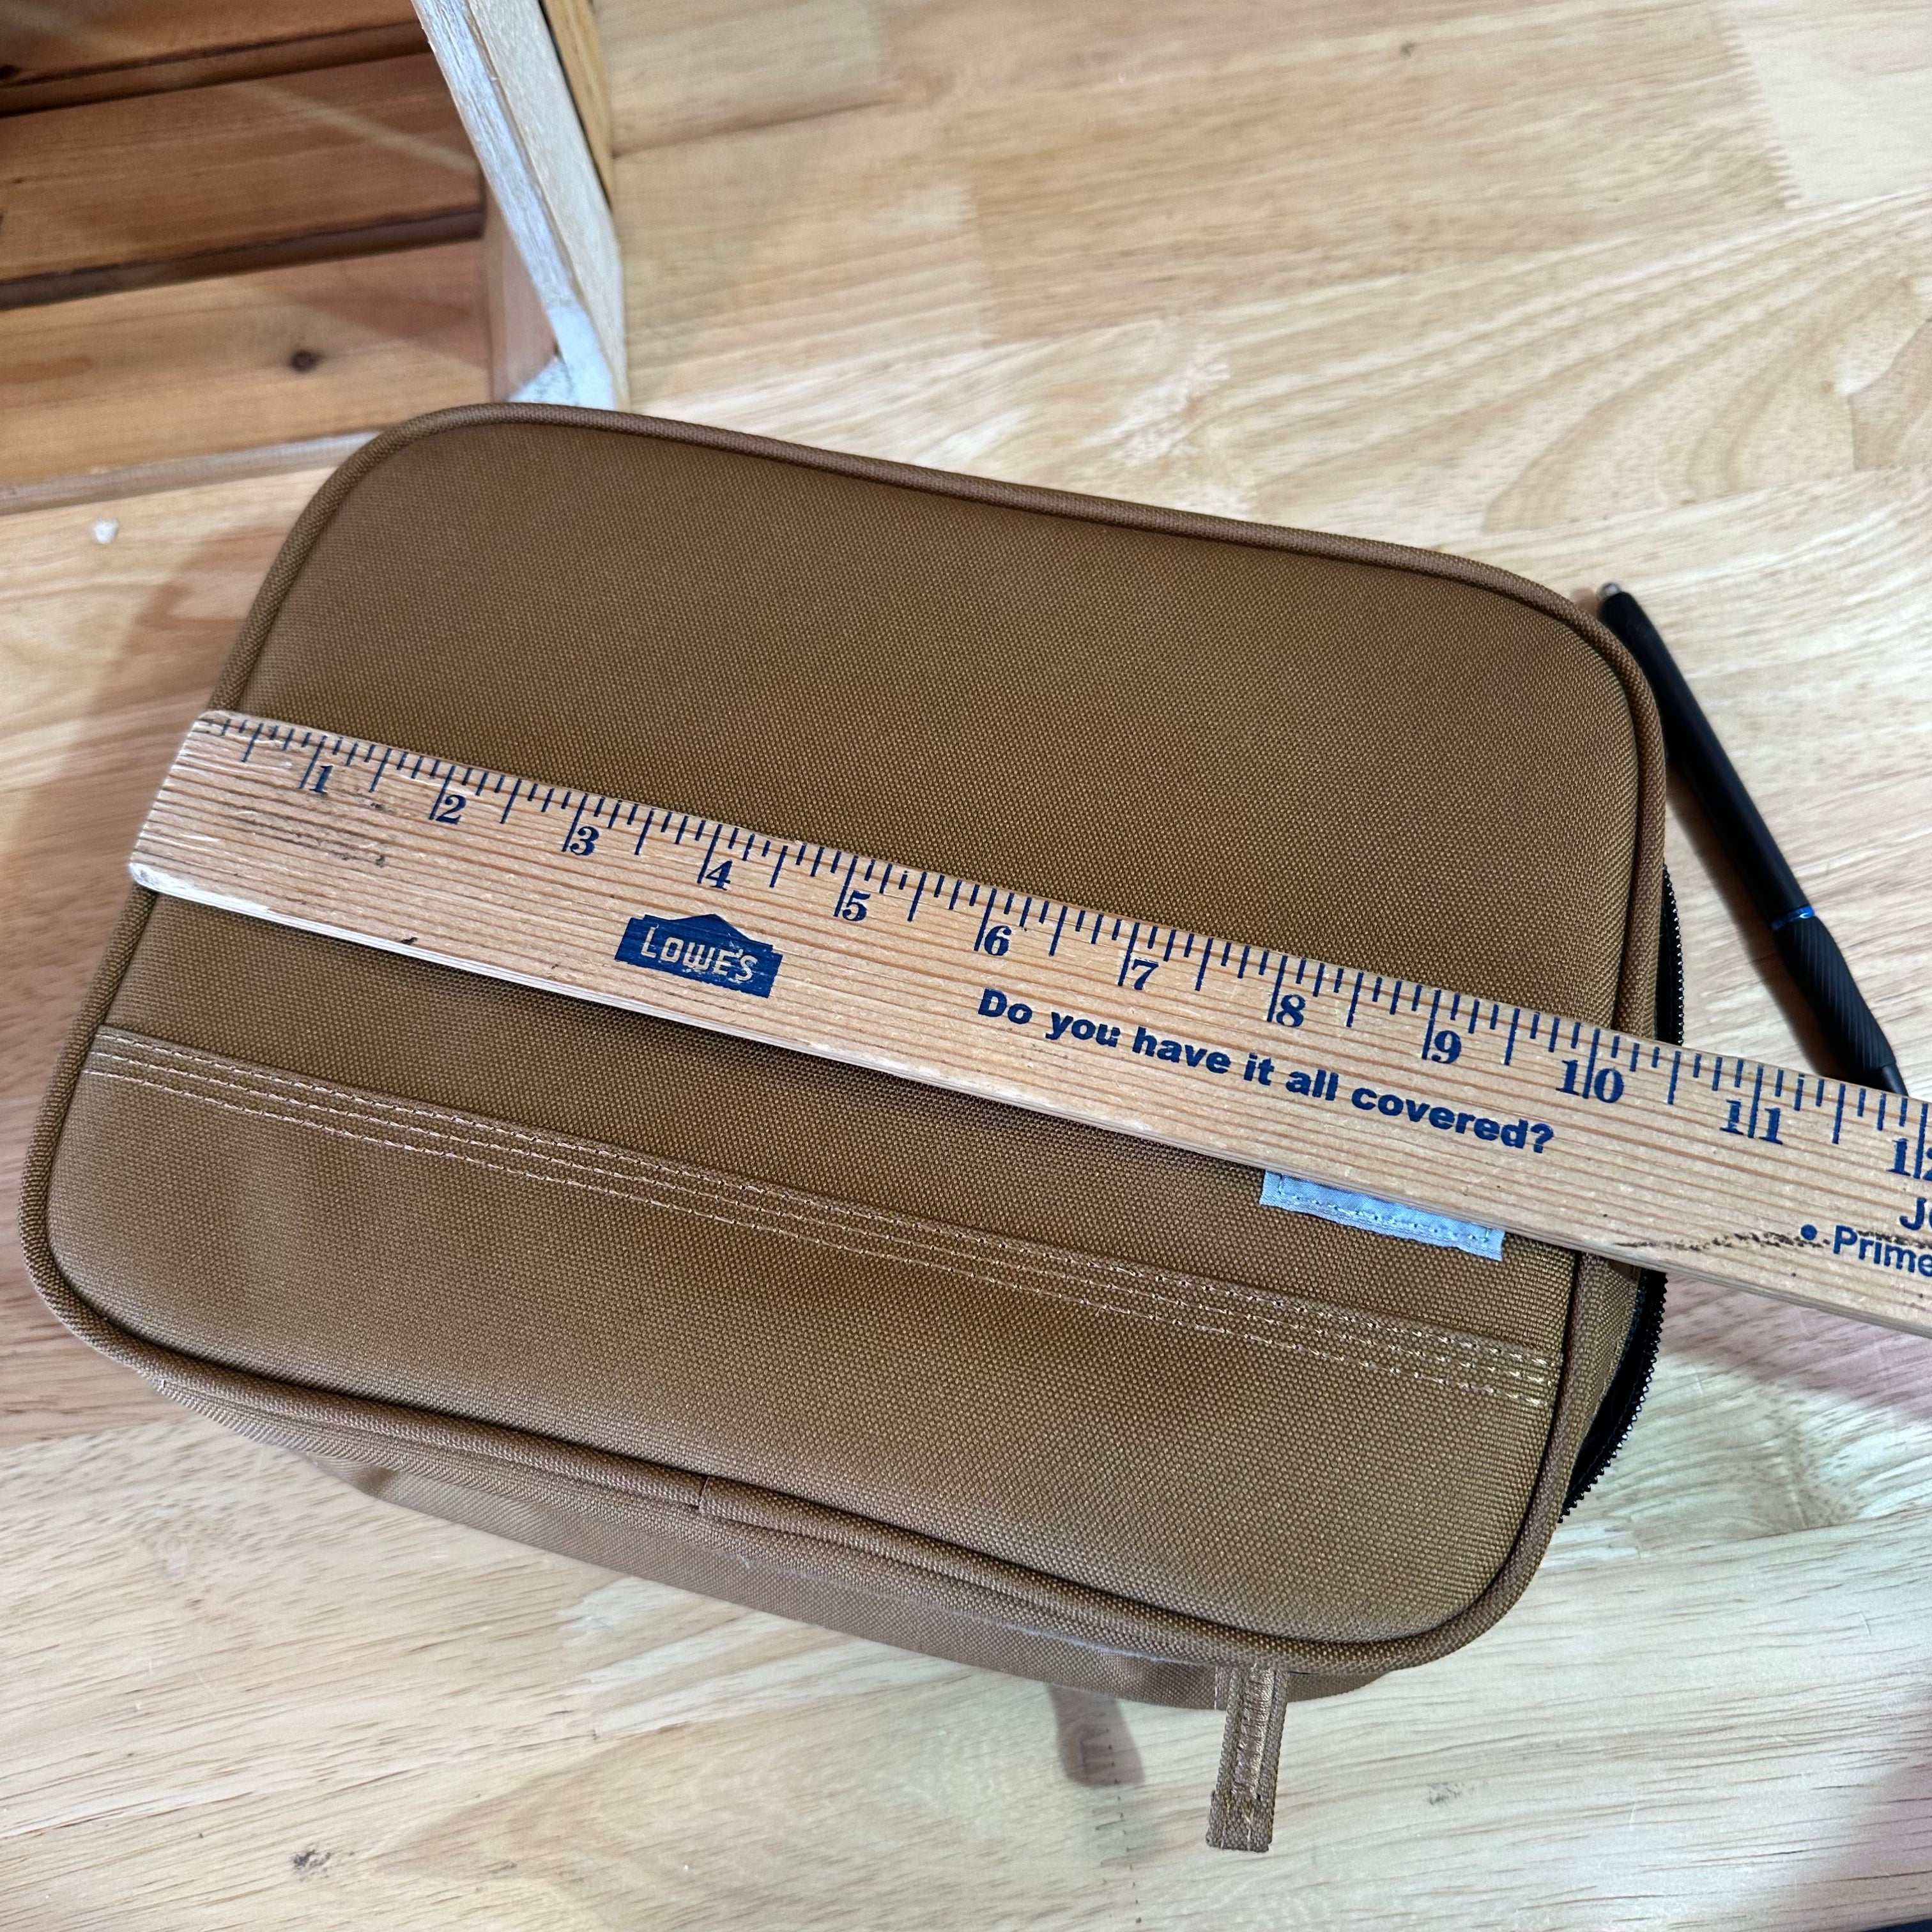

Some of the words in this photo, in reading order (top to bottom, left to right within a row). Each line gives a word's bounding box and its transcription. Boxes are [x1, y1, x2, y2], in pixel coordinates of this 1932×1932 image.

[309, 765, 334, 793] 1
[436, 795, 466, 824] 2
[570, 825, 600, 856] 3
[705, 859, 733, 891] 4
[841, 891, 871, 921] 5
[984, 924, 1012, 956] 6
[1130, 958, 1158, 990] 7
[1276, 994, 1307, 1028] 8
[1430, 1030, 1462, 1064] 9
[1556, 1059, 1625, 1104] 10
[1719, 1099, 1783, 1145] 11
[640, 925, 758, 983] LOWE'S
[977, 988, 1032, 1025] Do
[1045, 1011, 1121, 1047] you
[1132, 1026, 1231, 1074] have
[1243, 1052, 1274, 1086] it
[1285, 1070, 1338, 1101] all
[1351, 1087, 1554, 1154] covered?
